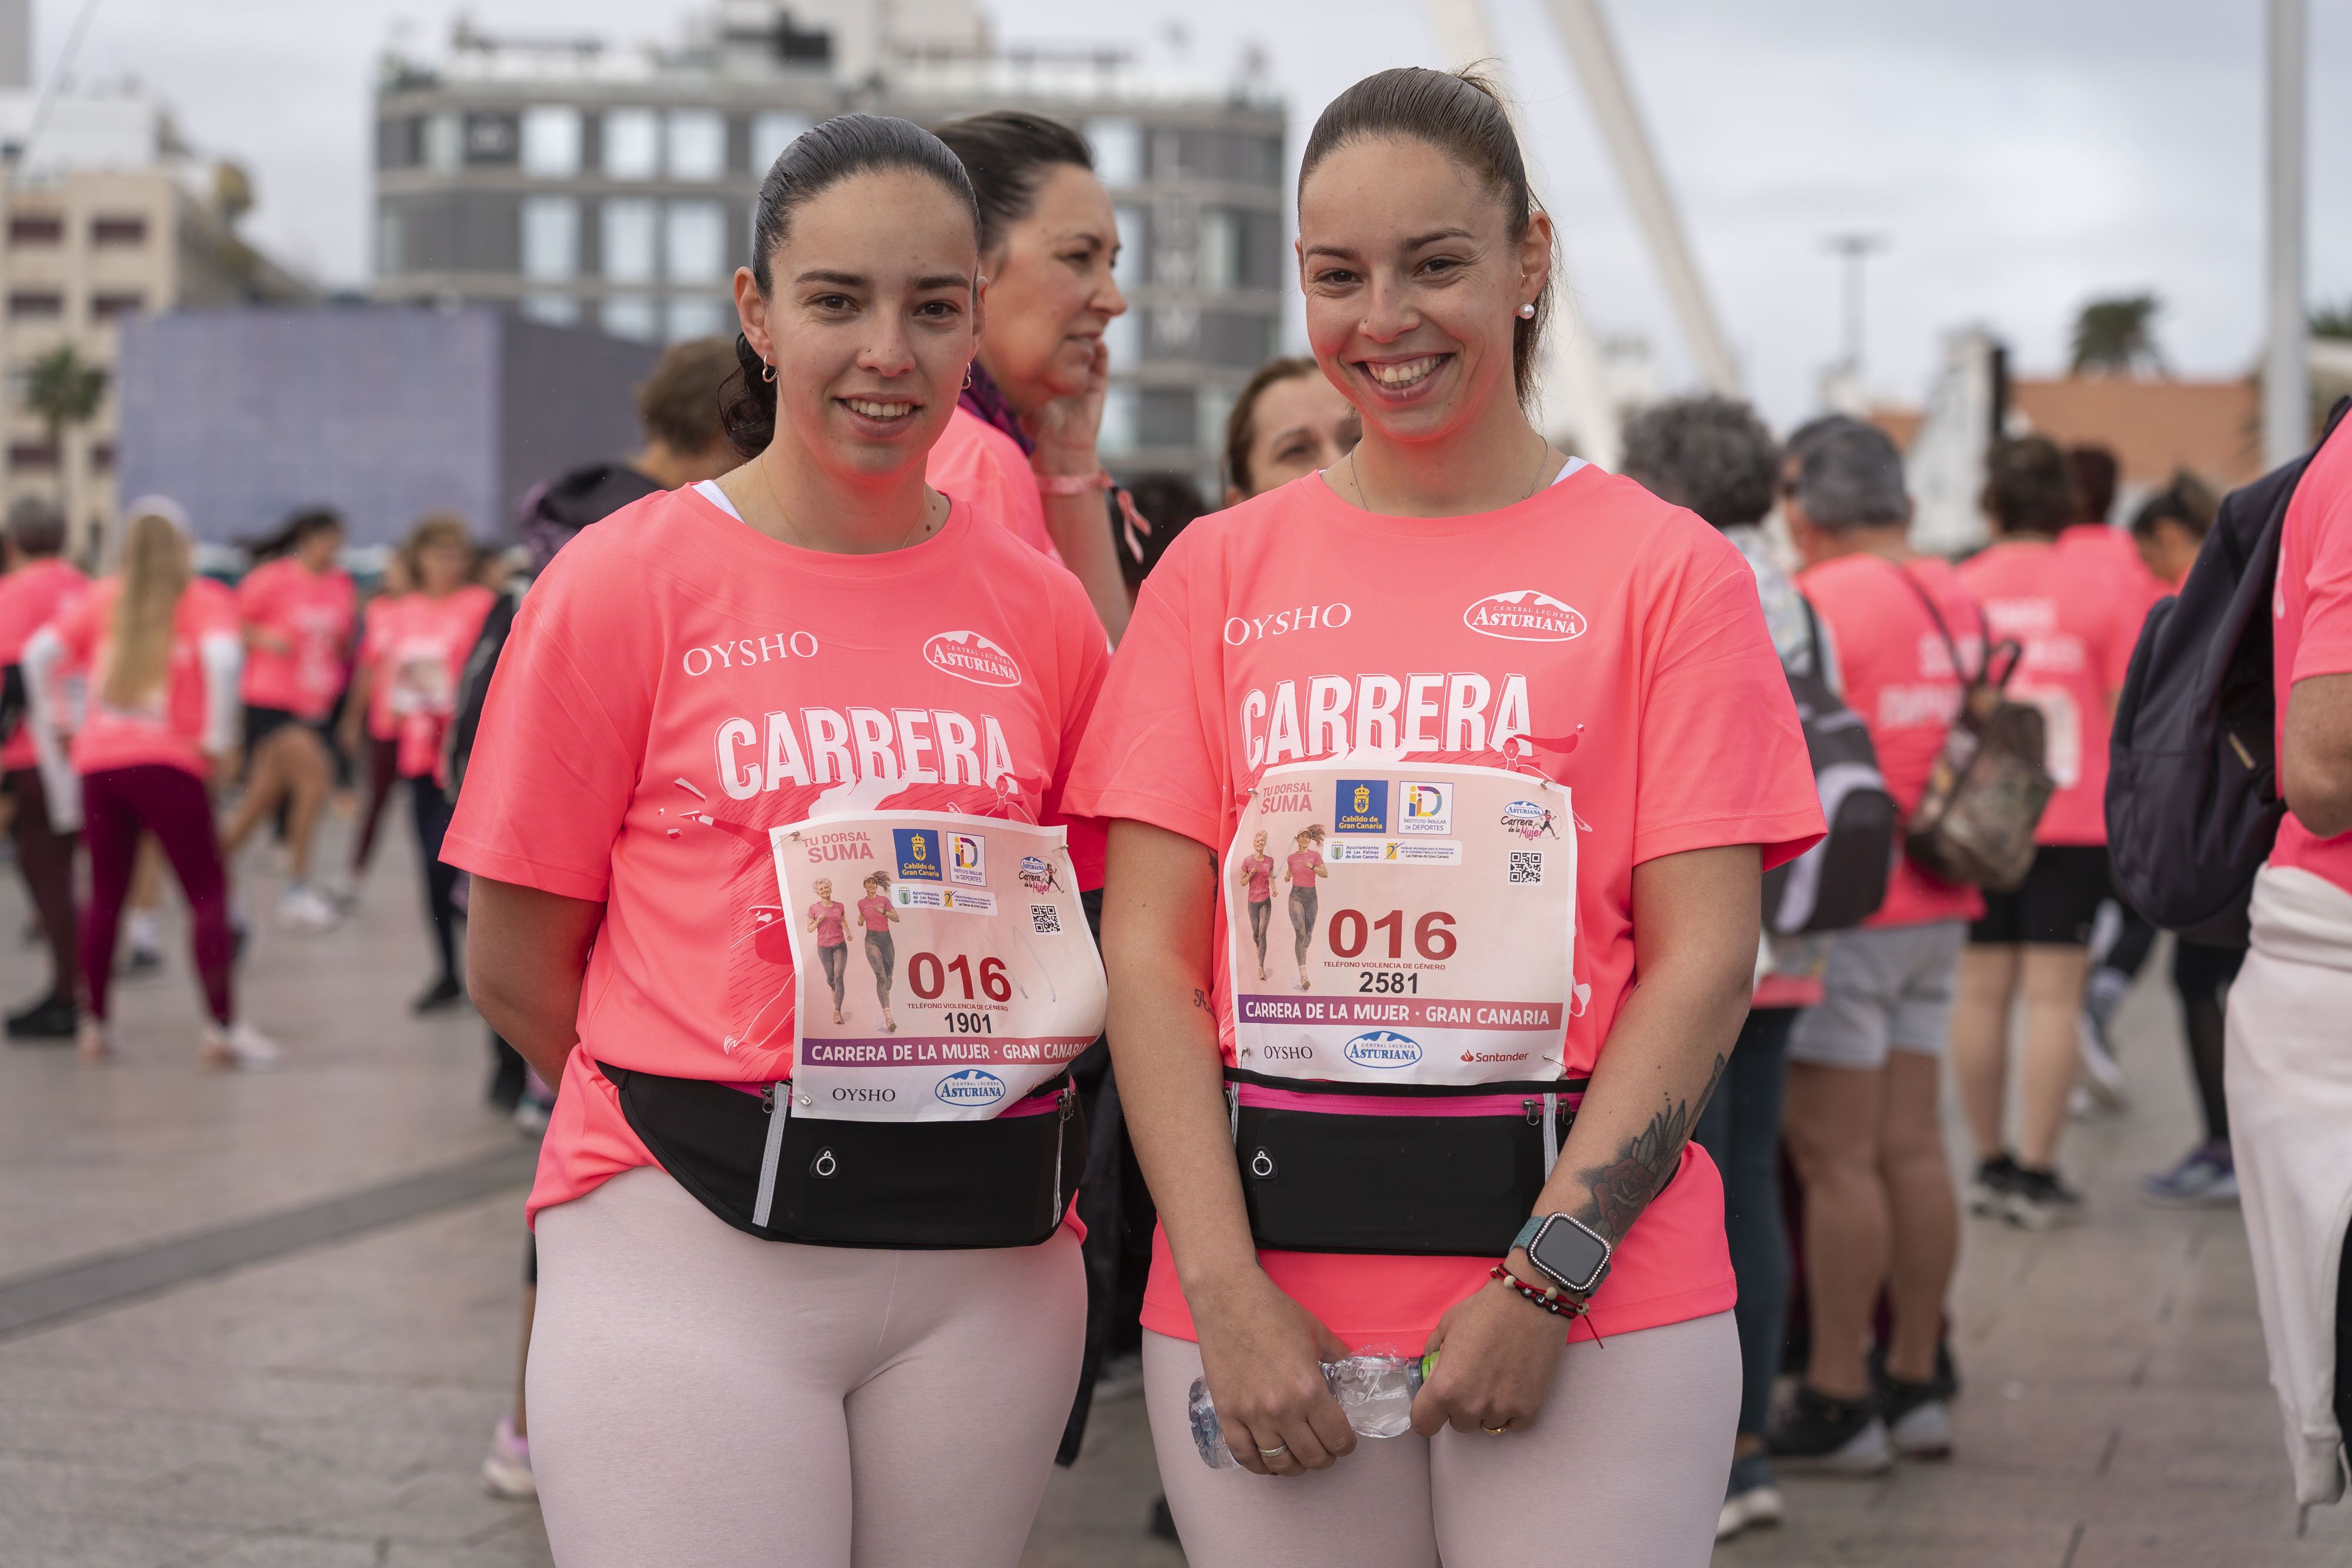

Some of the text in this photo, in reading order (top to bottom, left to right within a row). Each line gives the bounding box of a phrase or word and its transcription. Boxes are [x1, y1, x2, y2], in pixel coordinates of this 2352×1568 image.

[1472, 606, 1576, 634] ASTURIANA
[1536, 609, 1576, 620] LECHERA
[1224, 603, 1351, 645] OYSHO
[683, 631, 818, 676] OYSHO
[946, 644, 979, 656] CENTRAL
[933, 644, 1018, 681] ASTURIANA
[1240, 672, 1534, 773] CARRERA
[714, 707, 1020, 800] CARRERA
[1263, 783, 1312, 796] TU DORSAL
[1260, 794, 1312, 815] SUMA
[1508, 806, 1541, 815] ASTURIANA
[1501, 816, 1534, 826] Carrera
[802, 831, 871, 847] TU DORSAL
[1519, 825, 1543, 840] Mujer
[808, 842, 874, 863] SUMA
[918, 869, 940, 878] Canaria
[1023, 861, 1045, 870] ASTURIANA
[960, 874, 981, 882] DEPORTES
[1018, 871, 1041, 882] Carrera
[1328, 909, 1457, 961] 016
[1323, 960, 1359, 968] TELÉFONO
[1414, 961, 1446, 970] GÉNERO
[907, 952, 1012, 1002] 016
[1359, 971, 1418, 994] 2581
[1245, 1001, 1549, 1025] CARRERA DE LA MUJER GRAN CANARIA
[944, 1012, 992, 1034] 1901
[811, 1045, 886, 1061] CARRERA
[893, 1045, 912, 1061] DE
[918, 1045, 937, 1061] LA
[942, 1044, 990, 1059] MUJER
[1003, 1044, 1040, 1059] GRAN
[1264, 1045, 1313, 1060] OYSHO
[1349, 1044, 1416, 1060] ASTURIANA
[1475, 1052, 1529, 1062] Santander
[832, 1088, 896, 1102] OYSHO
[940, 1083, 1001, 1098] ASTURIANA
